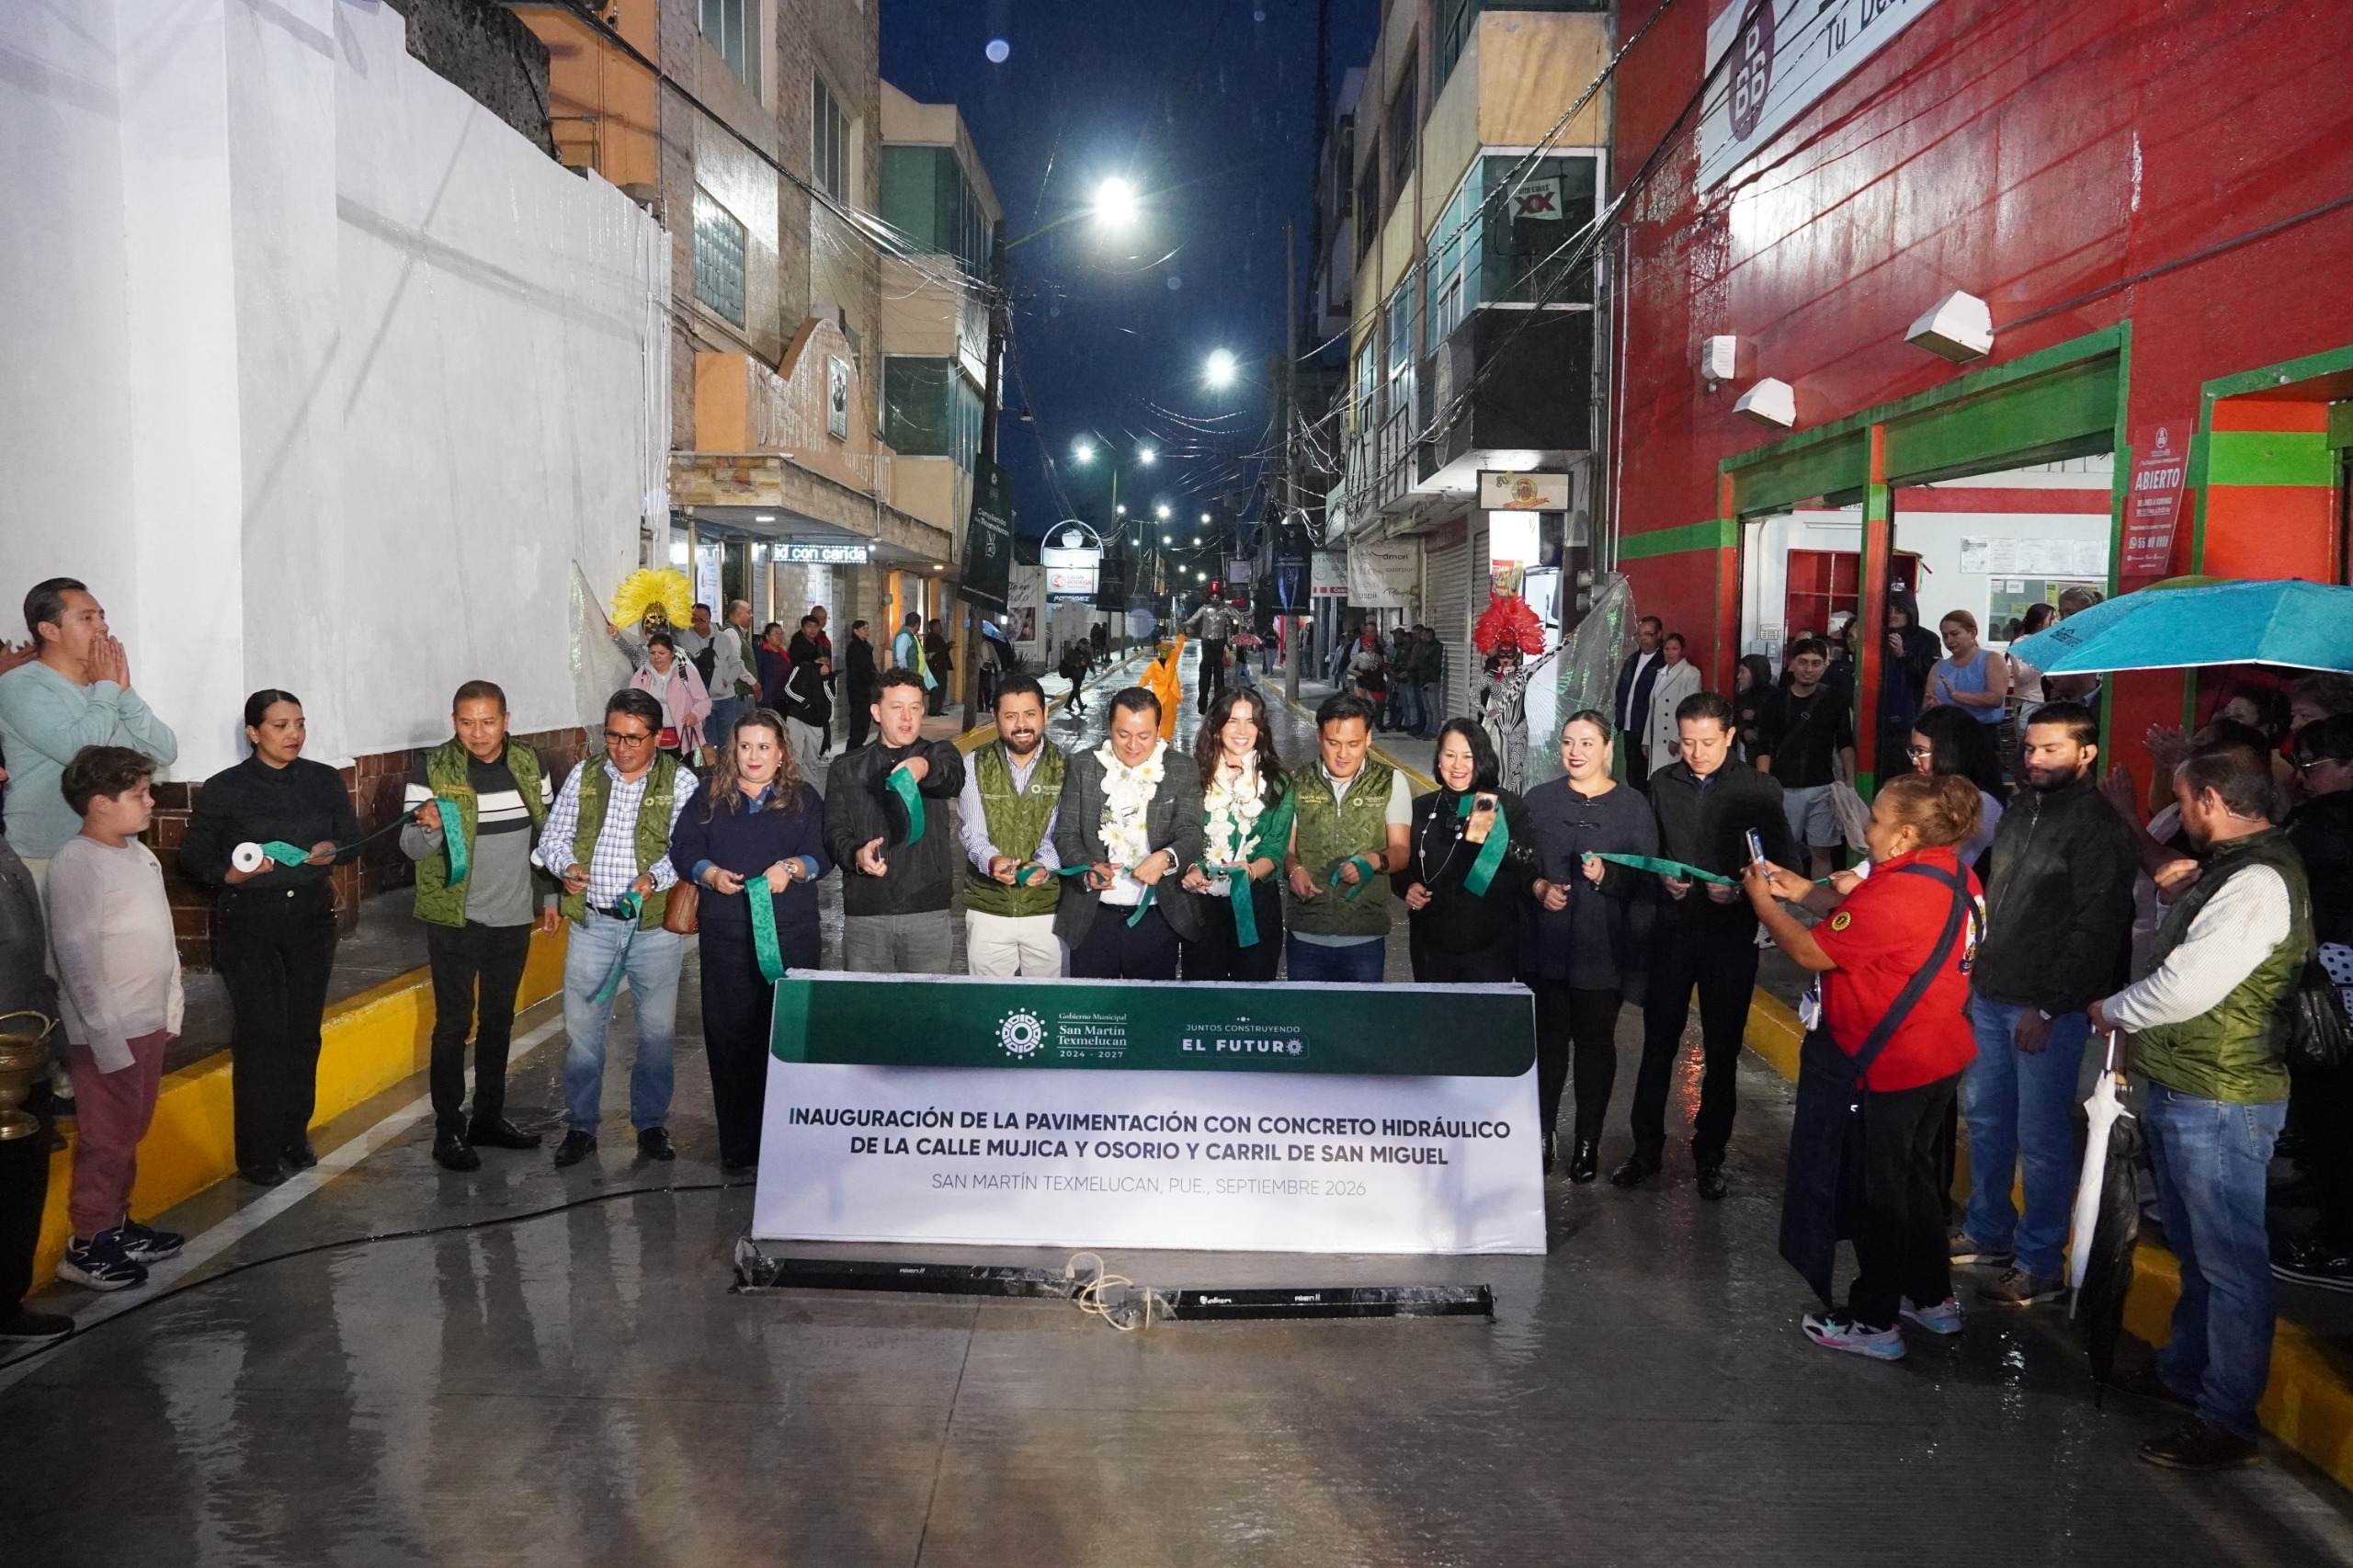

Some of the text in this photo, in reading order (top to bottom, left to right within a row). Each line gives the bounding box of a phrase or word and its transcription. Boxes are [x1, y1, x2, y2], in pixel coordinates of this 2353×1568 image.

[1825, 17, 1847, 59] Tu
[2135, 468, 2180, 491] ABIERTO
[977, 507, 1006, 527] Cumpliendo
[791, 548, 818, 560] con
[1093, 1013, 1127, 1022] Municipal
[1059, 1025, 1125, 1036] San Martín
[1224, 1025, 1301, 1033] CONSTRUYENDO
[1057, 1035, 1127, 1046] Texmelucan
[1182, 1039, 1206, 1051] EL
[1060, 1050, 1086, 1058] 2024
[1098, 1051, 1123, 1059] 2027
[790, 1107, 1510, 1139] INAUGURACIÓN DE LA PAVIMENTACIÓN CON CONCRETO HIDRÁULICO
[850, 1137, 1449, 1165] DE LA CALLE MUJICA Y OSORIO Y CARRIL DE SAN MIGUEL
[932, 1171, 1366, 1196] SAN MARTÍN TEXMELUCAN, PUE., SEPTIEMBRE 2026
